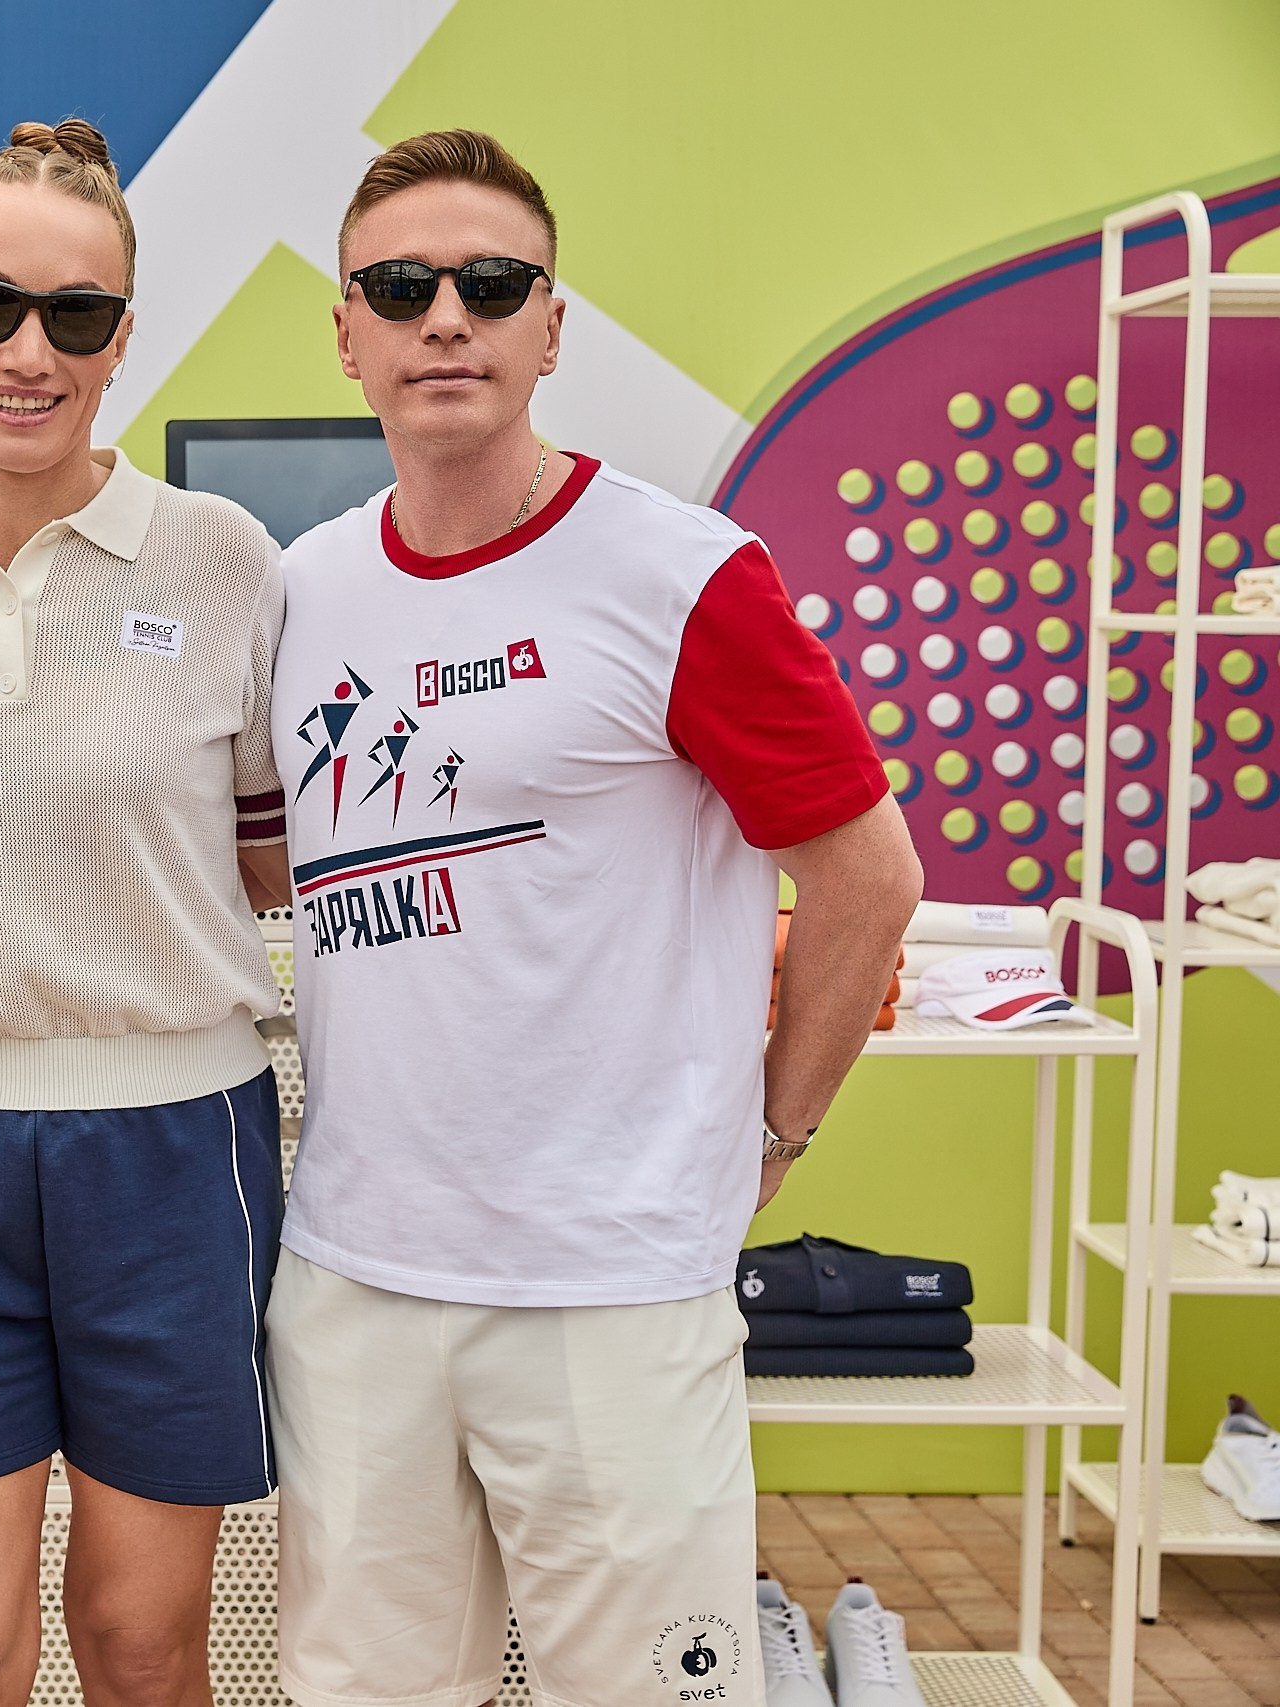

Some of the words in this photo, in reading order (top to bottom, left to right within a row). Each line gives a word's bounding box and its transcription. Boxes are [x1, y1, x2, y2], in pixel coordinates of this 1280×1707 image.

[134, 619, 173, 635] BOSCO
[133, 631, 155, 639] TENNIS
[157, 635, 172, 643] CLUB
[416, 656, 506, 707] BOSCO
[304, 867, 462, 958] ЗАРЯДКА
[985, 966, 1040, 983] BOSCO
[652, 1620, 682, 1684] SVETLANA
[688, 1614, 741, 1676] KUZNETSOVA
[679, 1683, 726, 1701] svet
